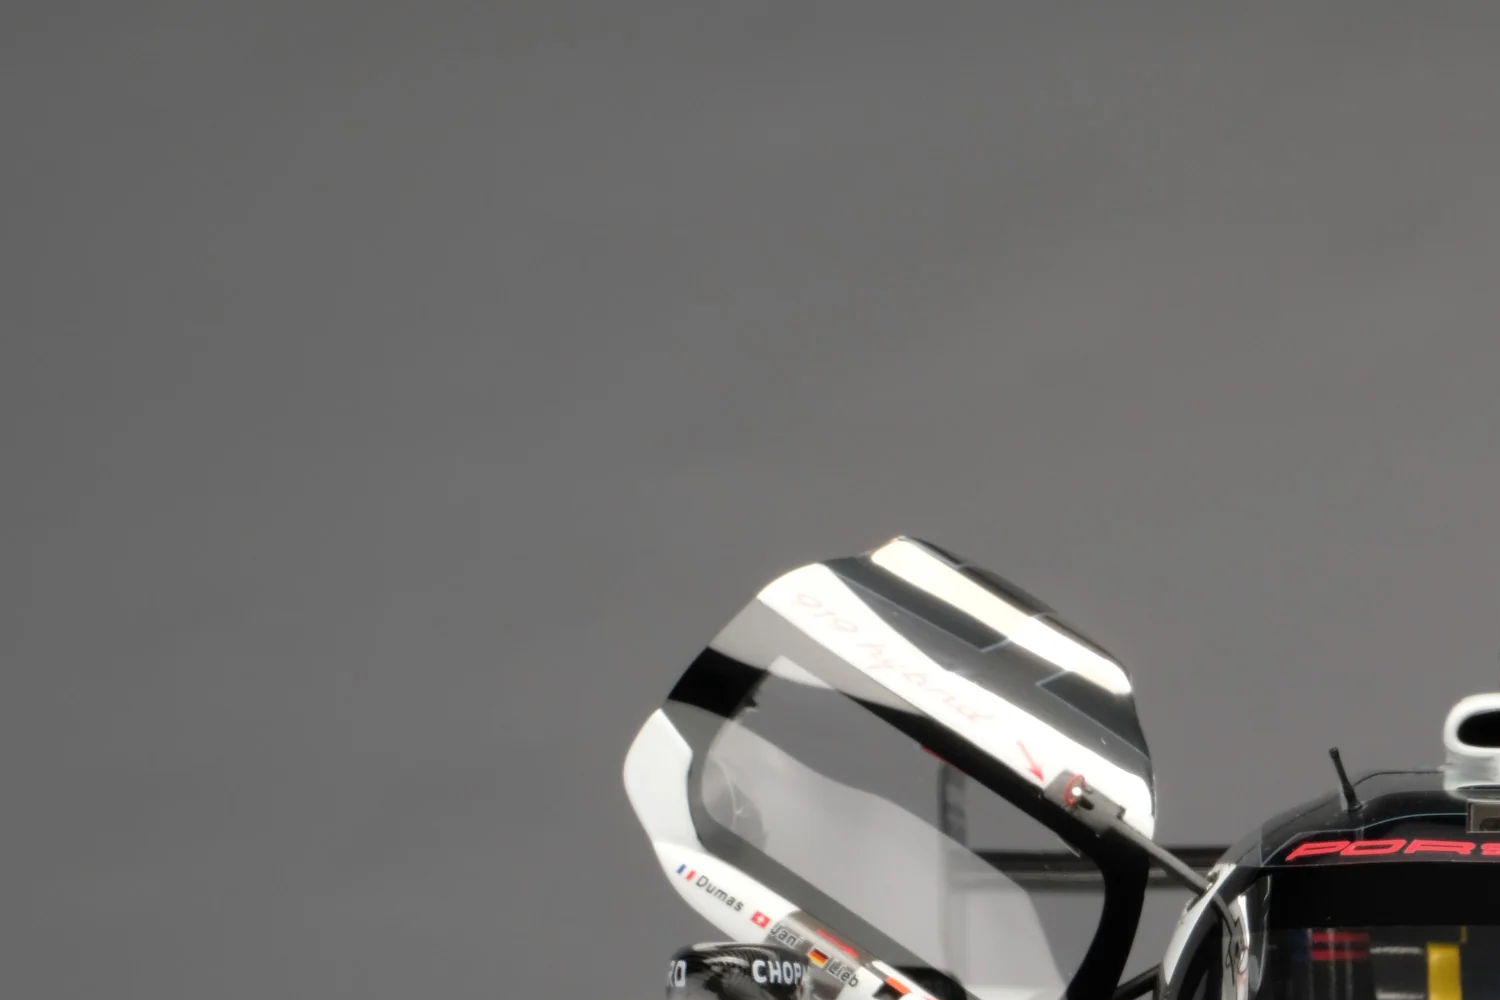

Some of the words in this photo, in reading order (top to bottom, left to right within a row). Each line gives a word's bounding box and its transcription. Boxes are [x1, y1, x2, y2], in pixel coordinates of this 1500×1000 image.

[695, 875, 744, 912] Dumas
[827, 958, 859, 988] Lieb
[752, 959, 805, 985] CHOP
